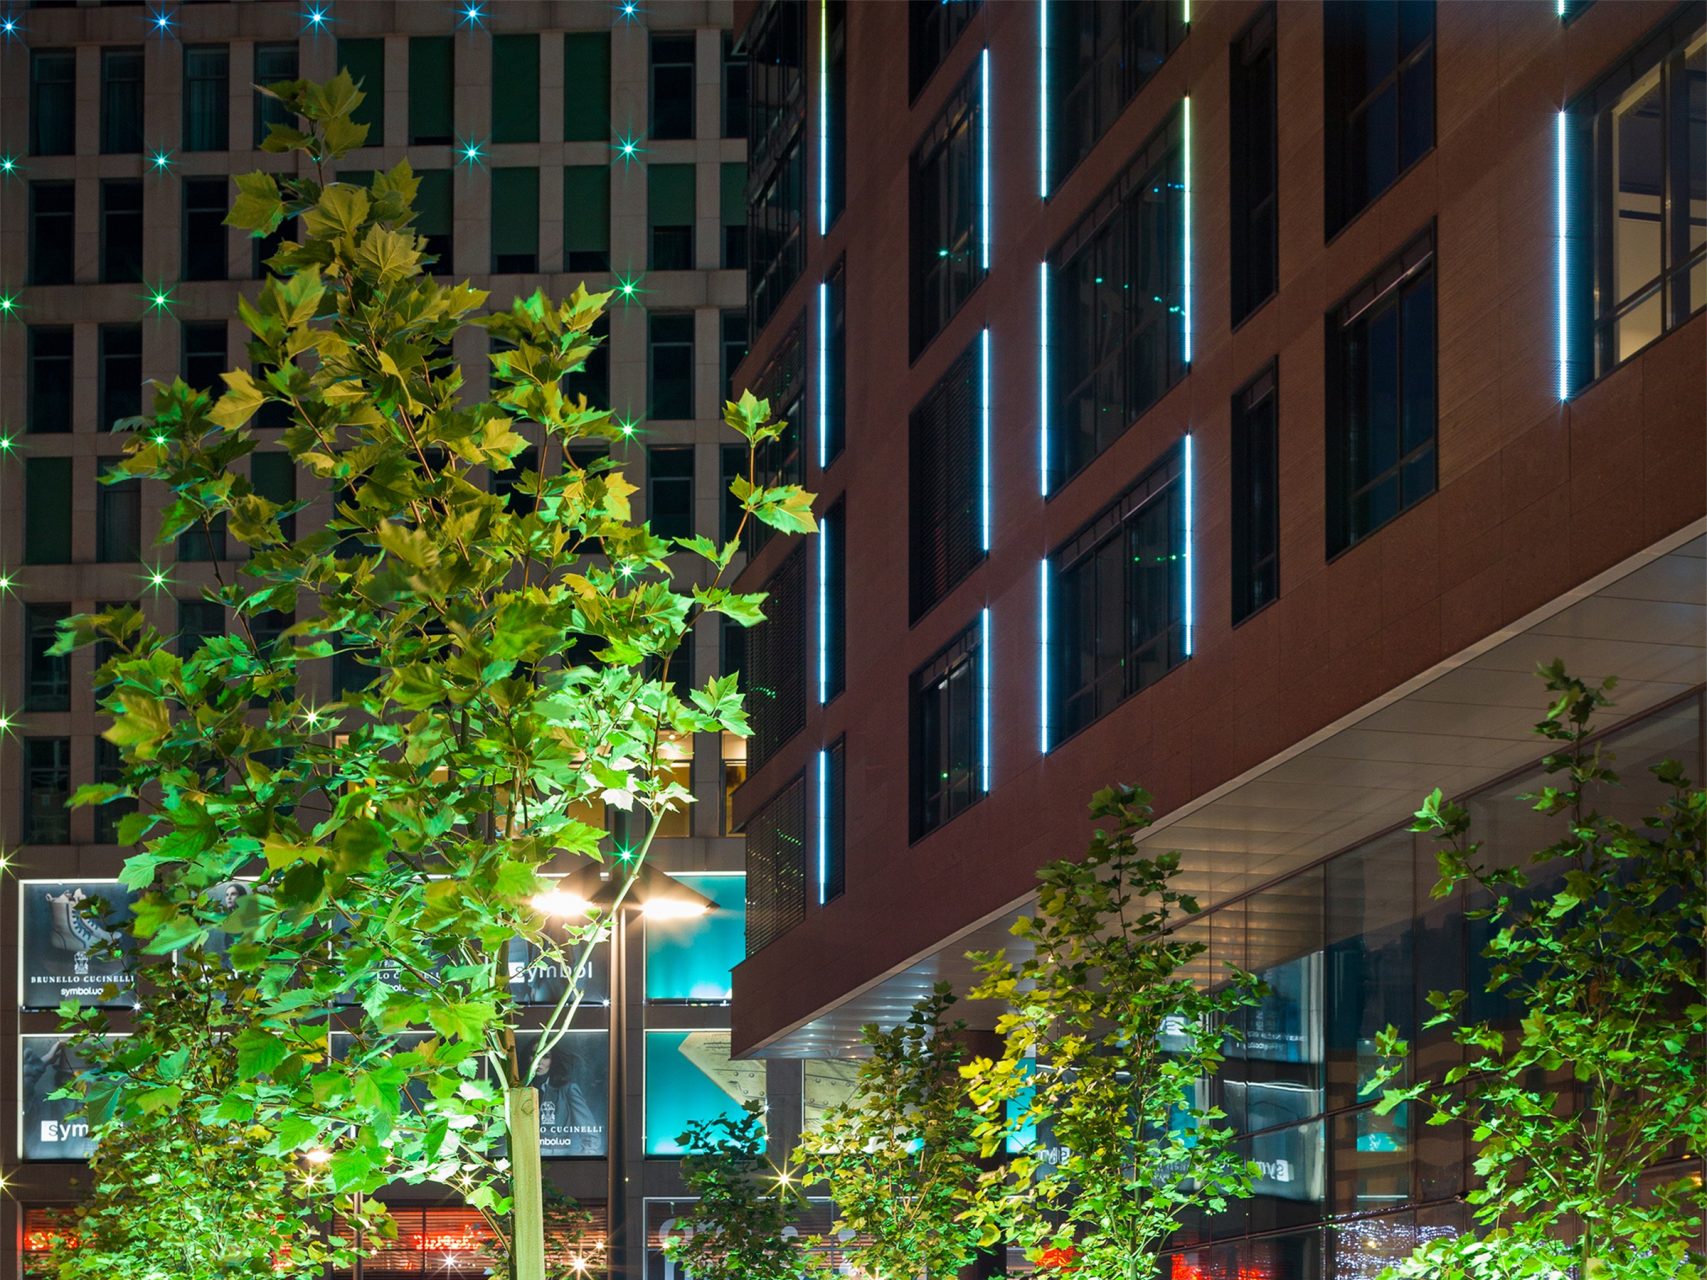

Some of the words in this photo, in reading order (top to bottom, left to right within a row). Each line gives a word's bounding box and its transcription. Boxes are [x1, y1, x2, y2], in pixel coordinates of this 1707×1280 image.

[30, 975, 80, 983] BRUNELLO
[83, 975, 134, 983] CUCINELLI
[42, 1120, 89, 1141] sym
[550, 1125, 602, 1133] CUCINELLI
